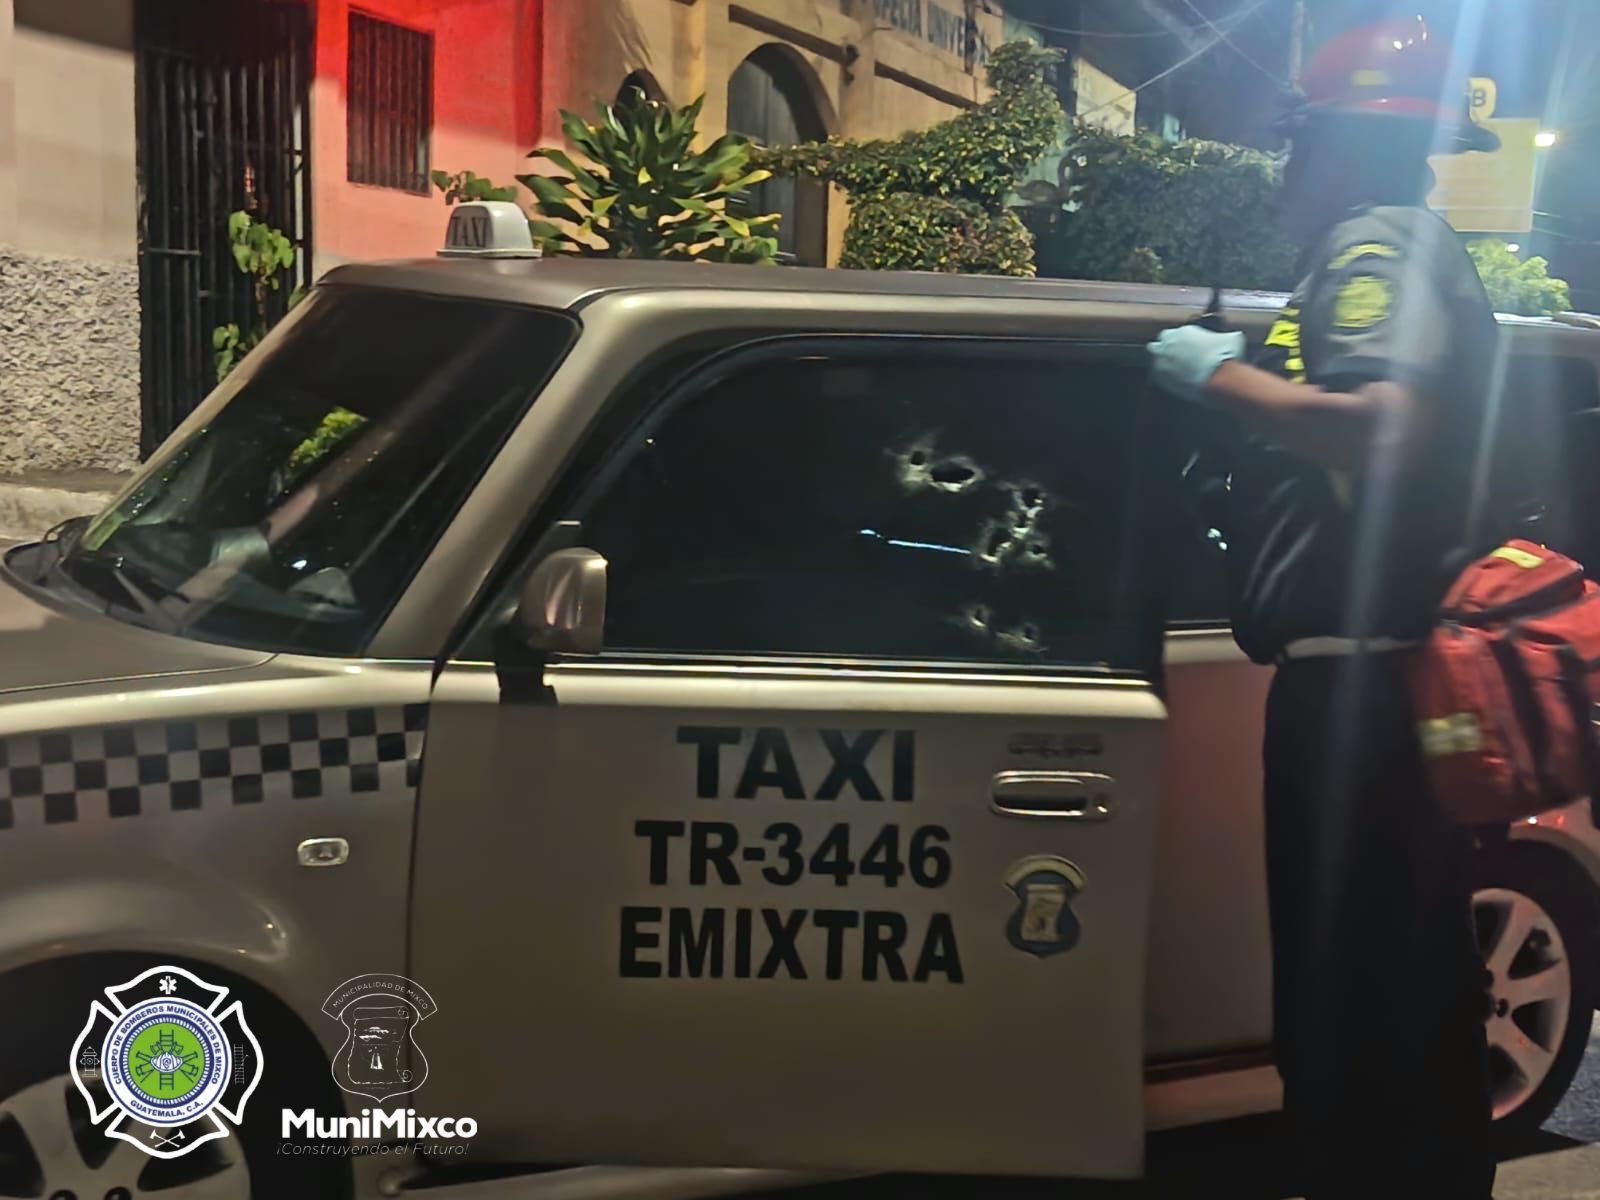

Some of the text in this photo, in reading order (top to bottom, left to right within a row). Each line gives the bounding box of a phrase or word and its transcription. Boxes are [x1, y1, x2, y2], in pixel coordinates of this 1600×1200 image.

[450, 216, 490, 248] TAXI
[676, 726, 916, 803] TAXI
[634, 819, 952, 889] TR-3446
[618, 906, 965, 985] EMIXTRA
